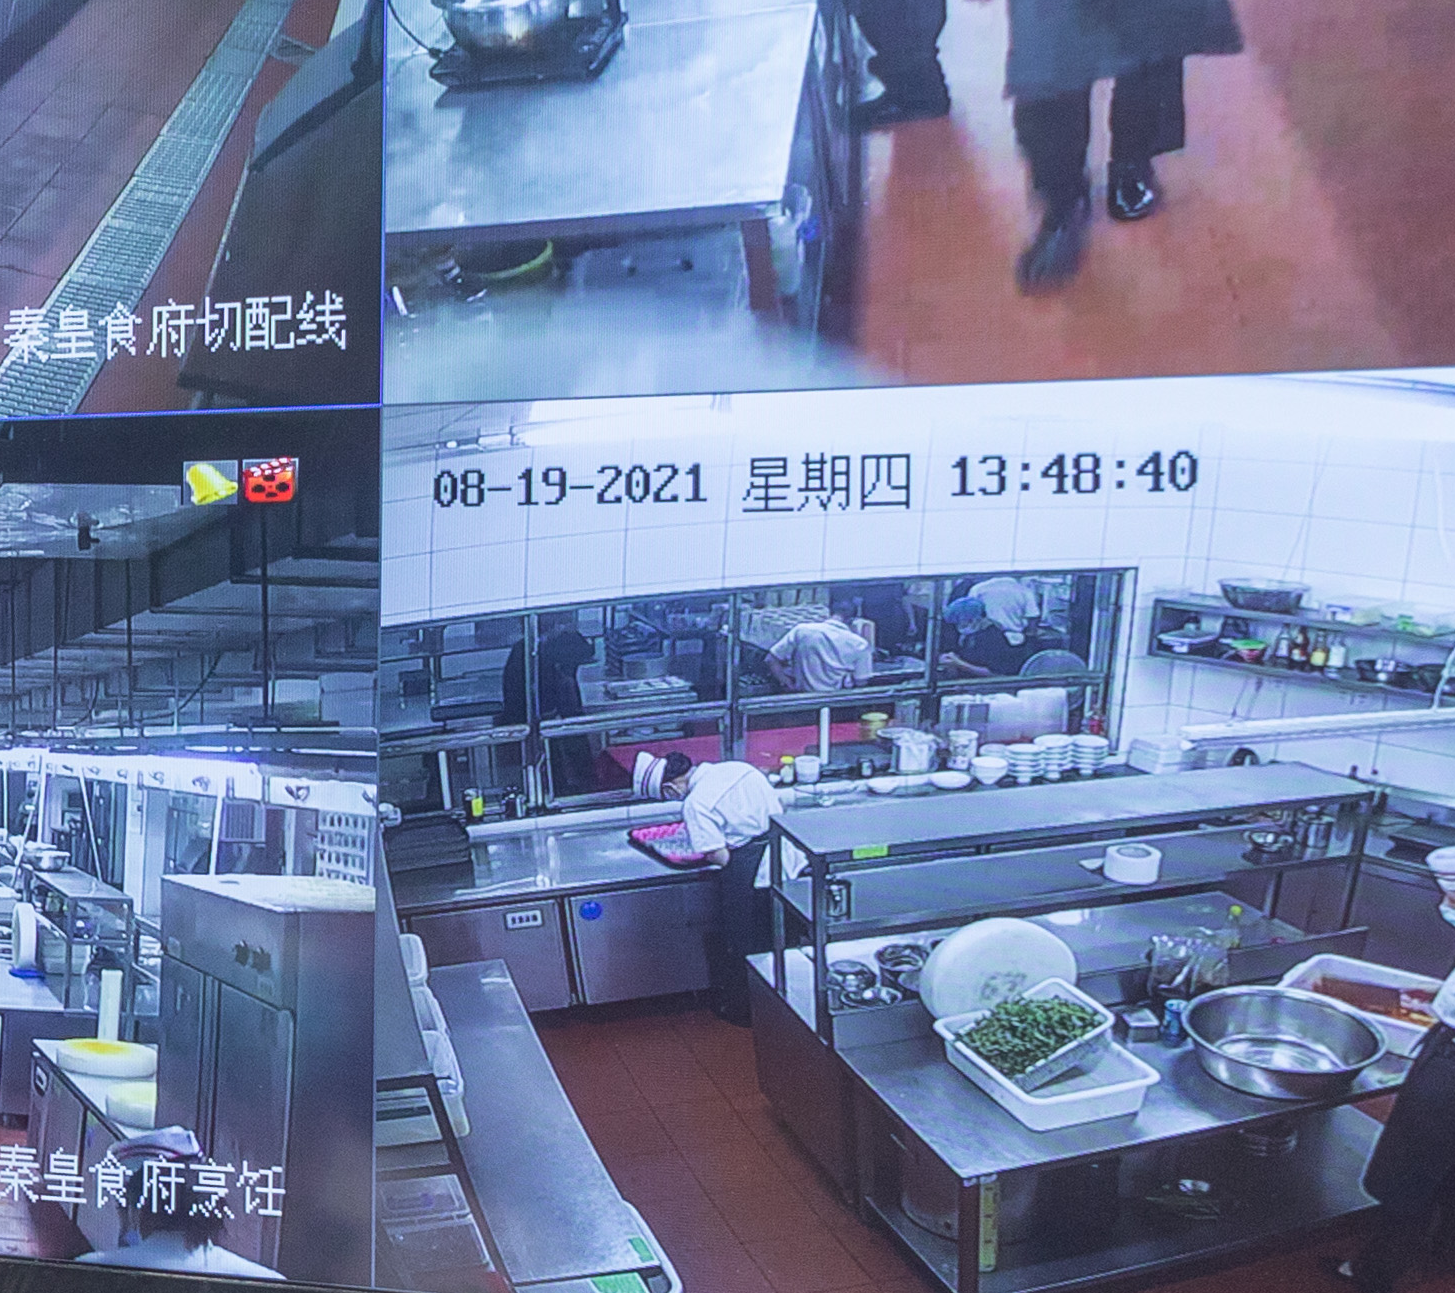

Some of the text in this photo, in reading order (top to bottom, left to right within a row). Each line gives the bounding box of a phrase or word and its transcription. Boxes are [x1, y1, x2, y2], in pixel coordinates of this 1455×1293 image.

[3, 290, 347, 362] 秦皇食府切配线
[432, 450, 1198, 513] 08-19-2021 星期四 13:48:40
